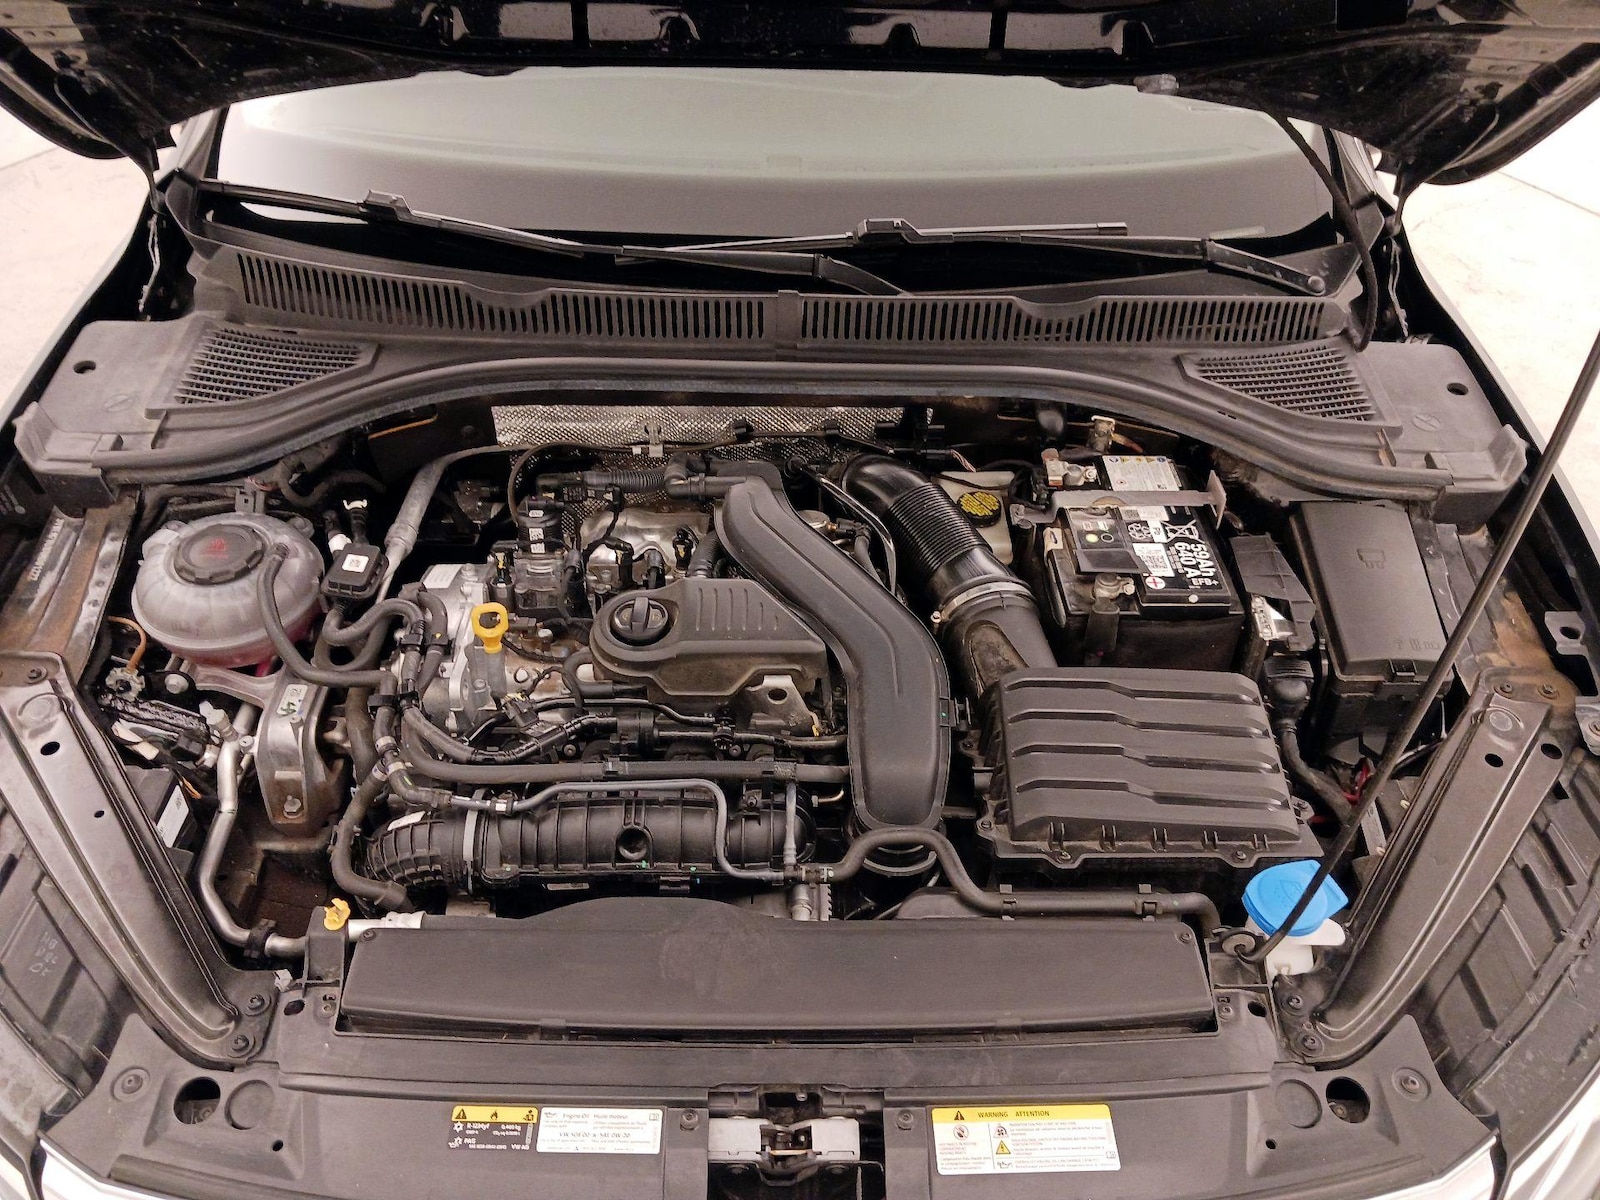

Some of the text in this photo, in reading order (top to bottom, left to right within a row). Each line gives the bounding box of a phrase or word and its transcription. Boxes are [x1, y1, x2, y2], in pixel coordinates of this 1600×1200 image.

[1174, 541, 1197, 566] 640
[1190, 543, 1217, 577] 59Ah
[1184, 567, 1202, 578] A
